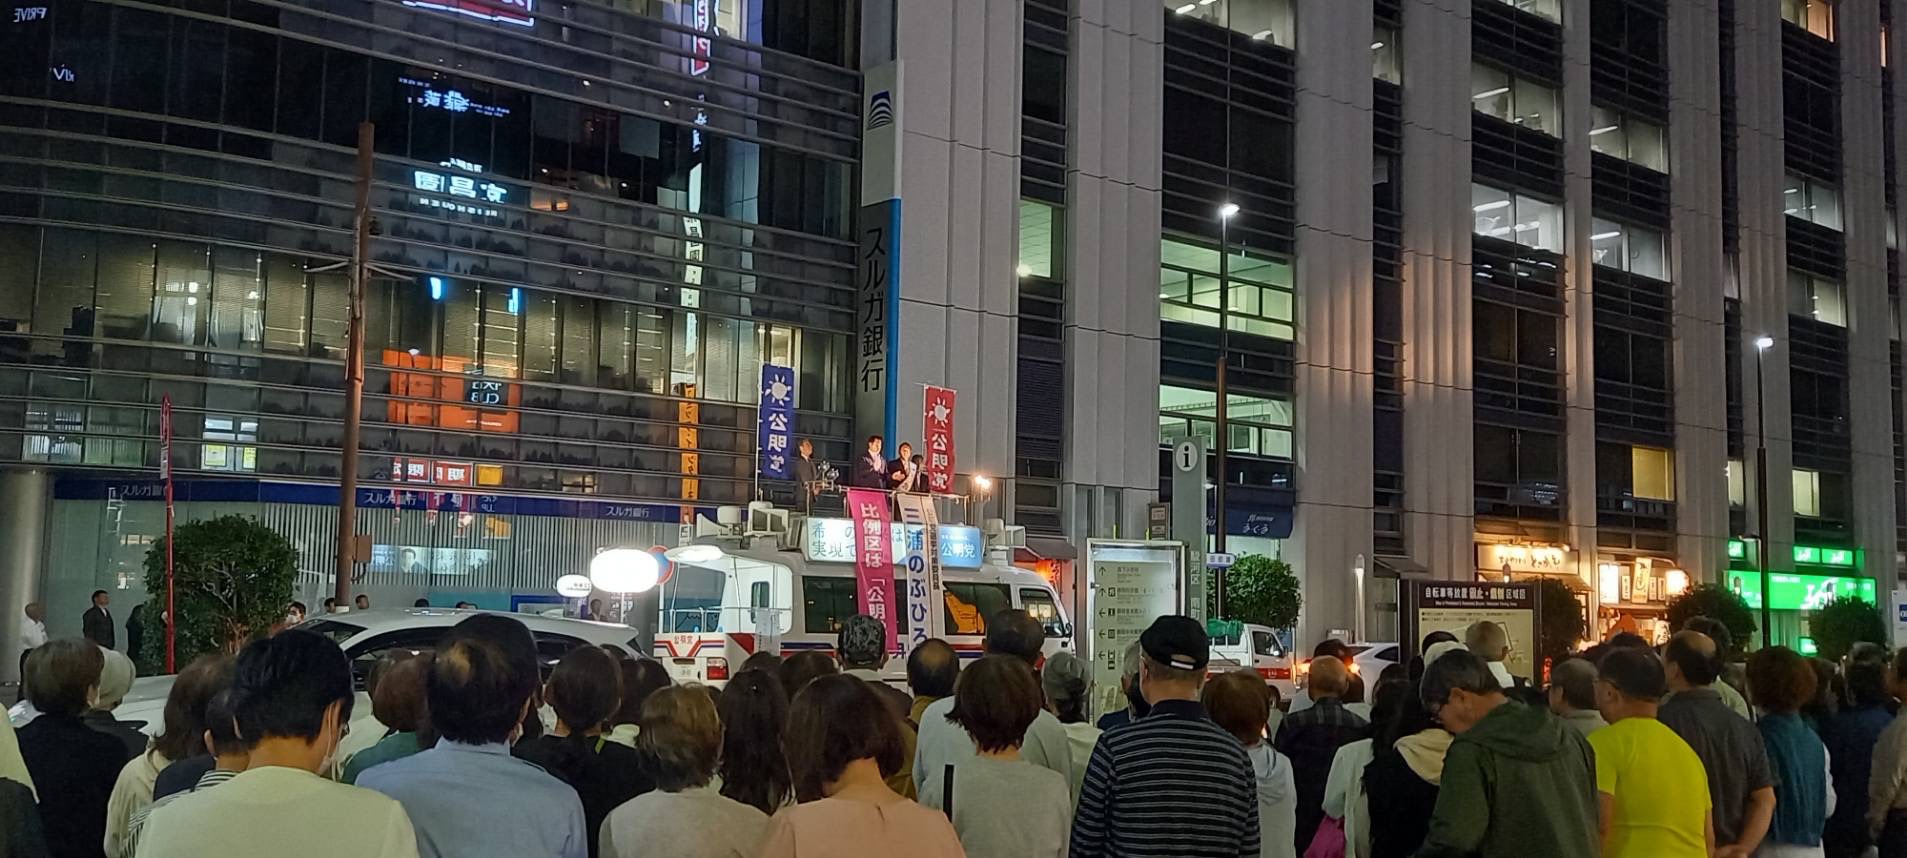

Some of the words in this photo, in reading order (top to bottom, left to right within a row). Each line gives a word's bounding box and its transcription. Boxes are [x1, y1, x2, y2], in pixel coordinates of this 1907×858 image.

[861, 226, 886, 393] スルガ銀行
[606, 506, 649, 518] スルガ銀行
[860, 502, 887, 622] 比例区は「公明
[941, 542, 976, 559] 公明党
[904, 506, 928, 642] 三浦のぶひろ
